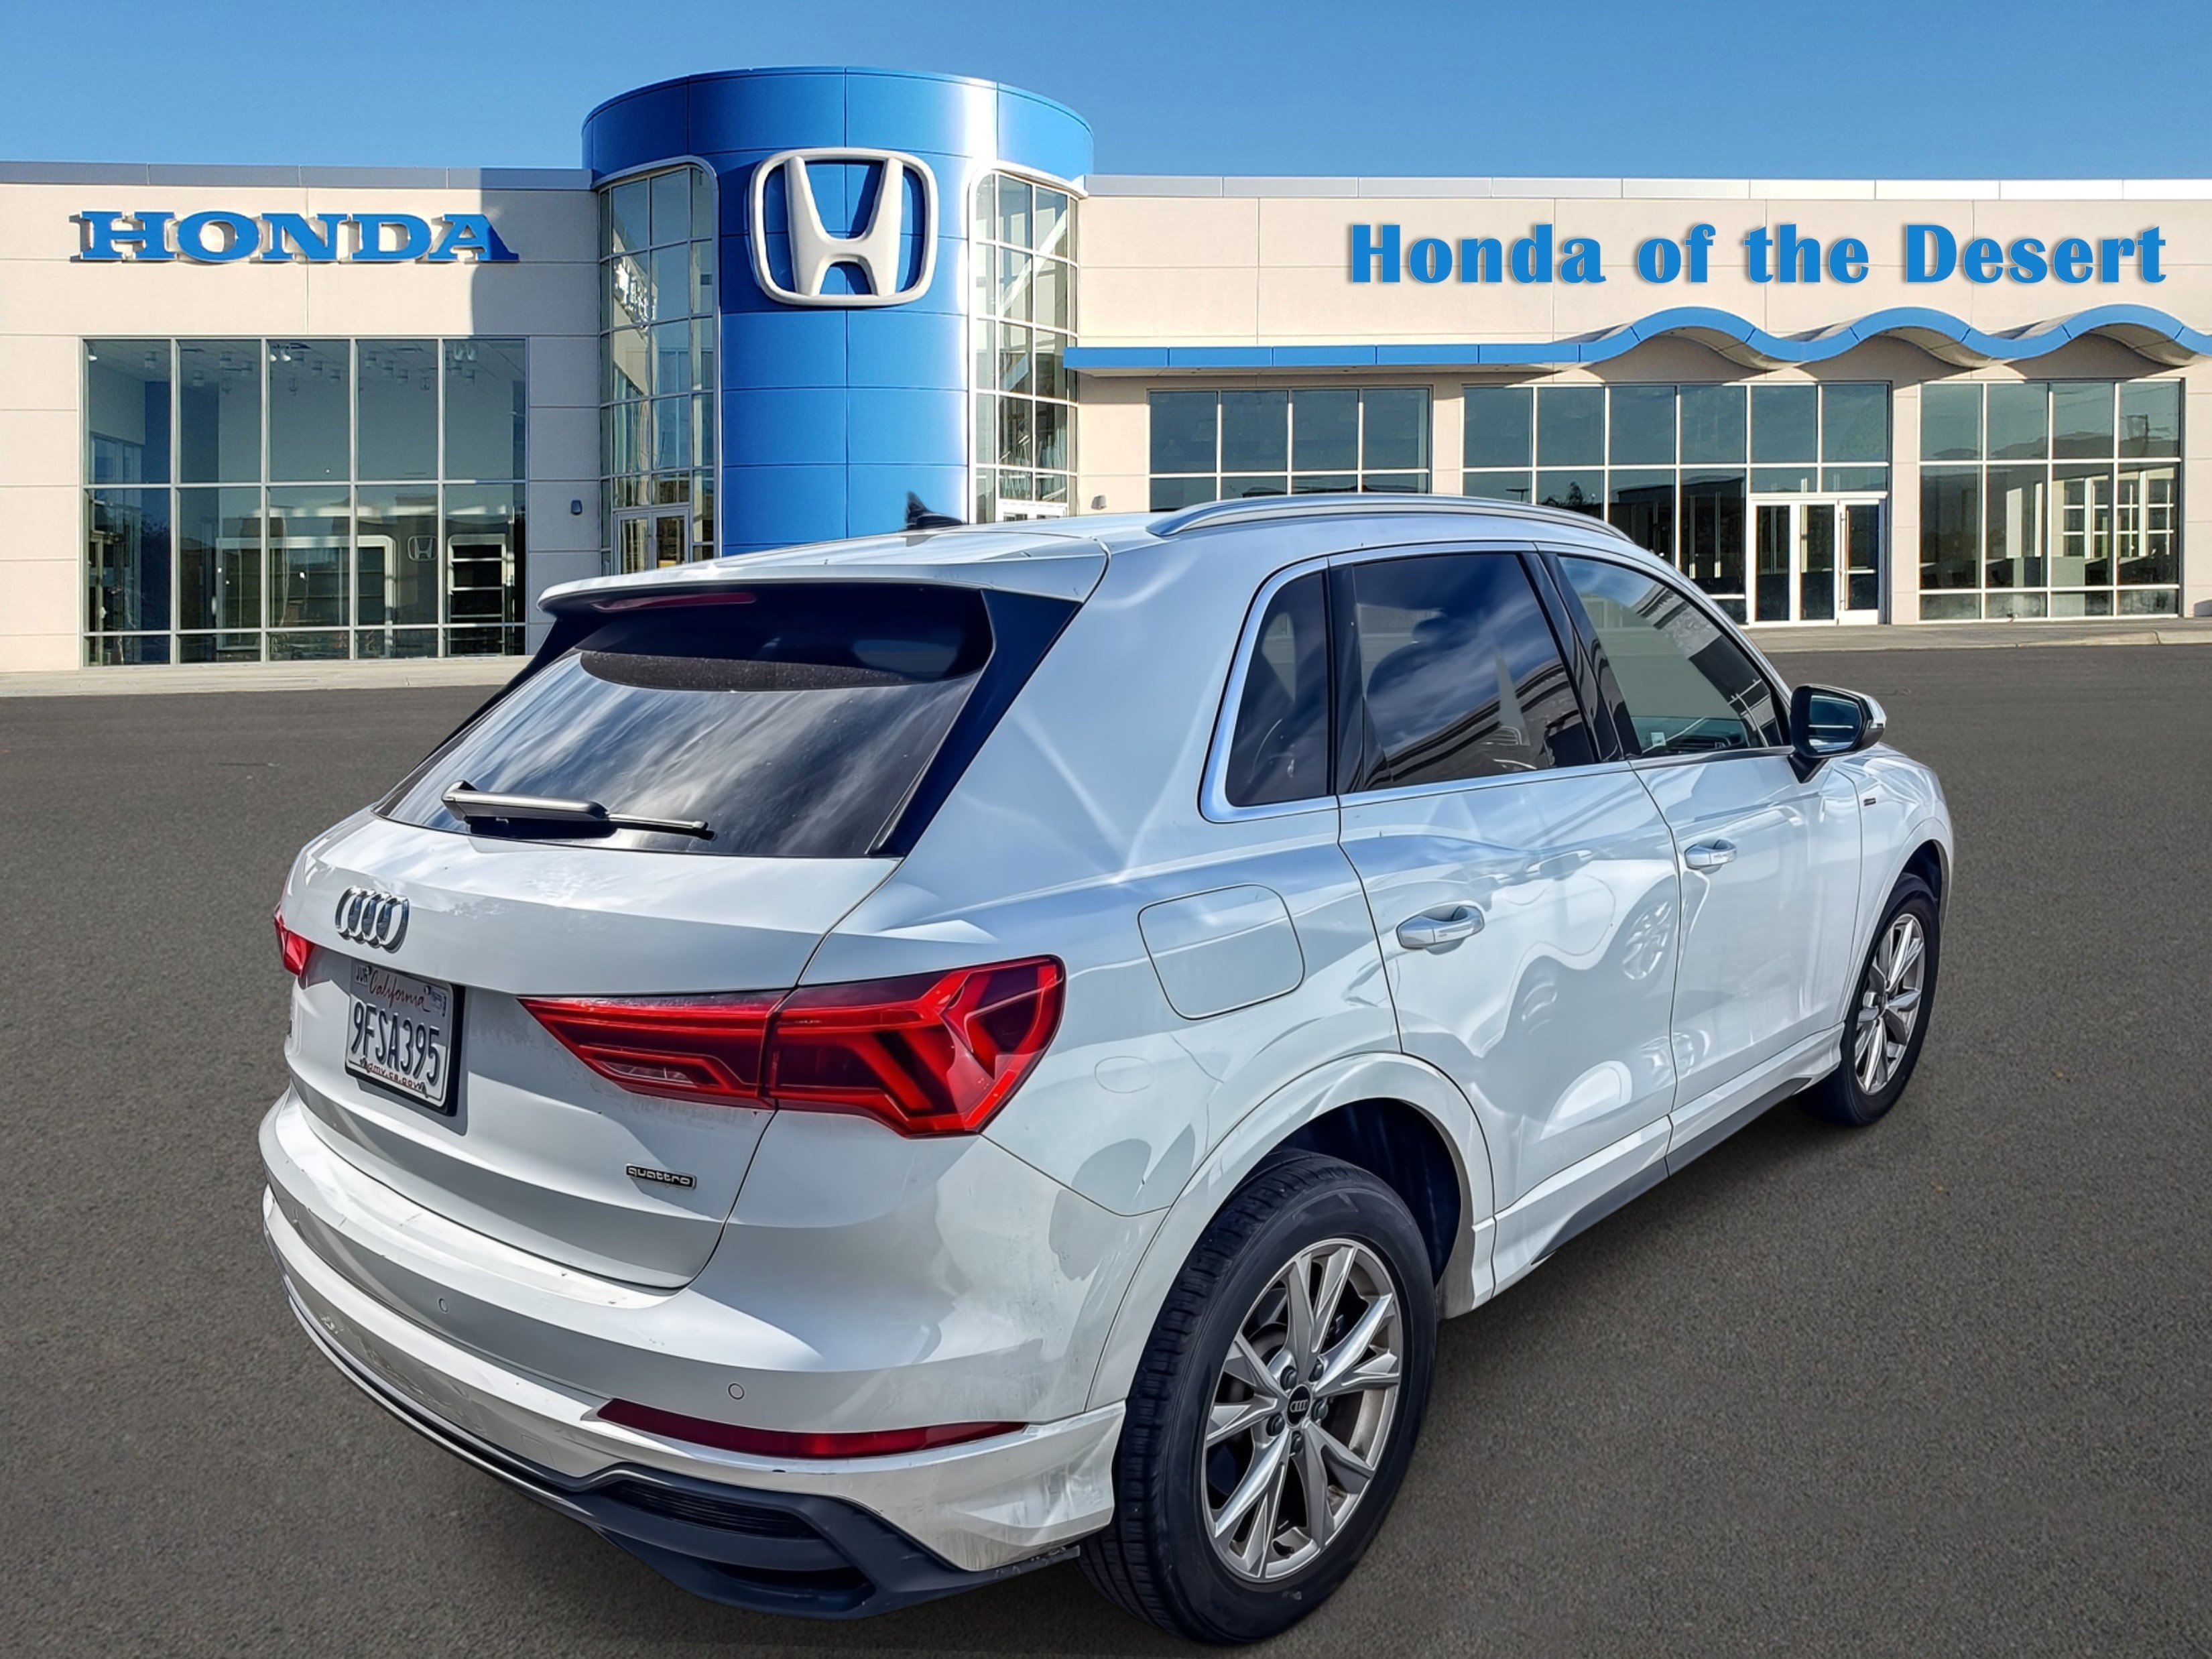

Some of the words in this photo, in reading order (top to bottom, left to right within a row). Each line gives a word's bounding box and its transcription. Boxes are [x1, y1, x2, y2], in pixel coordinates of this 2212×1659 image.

[71, 211, 519, 262] HONDA
[1352, 223, 1607, 284] Honda
[1638, 223, 1717, 284] of
[1743, 223, 1869, 284] the
[1906, 224, 2166, 284] Desert
[369, 970, 431, 1013] California
[351, 1001, 440, 1086] 9FSA395
[628, 1168, 690, 1184] quattro
